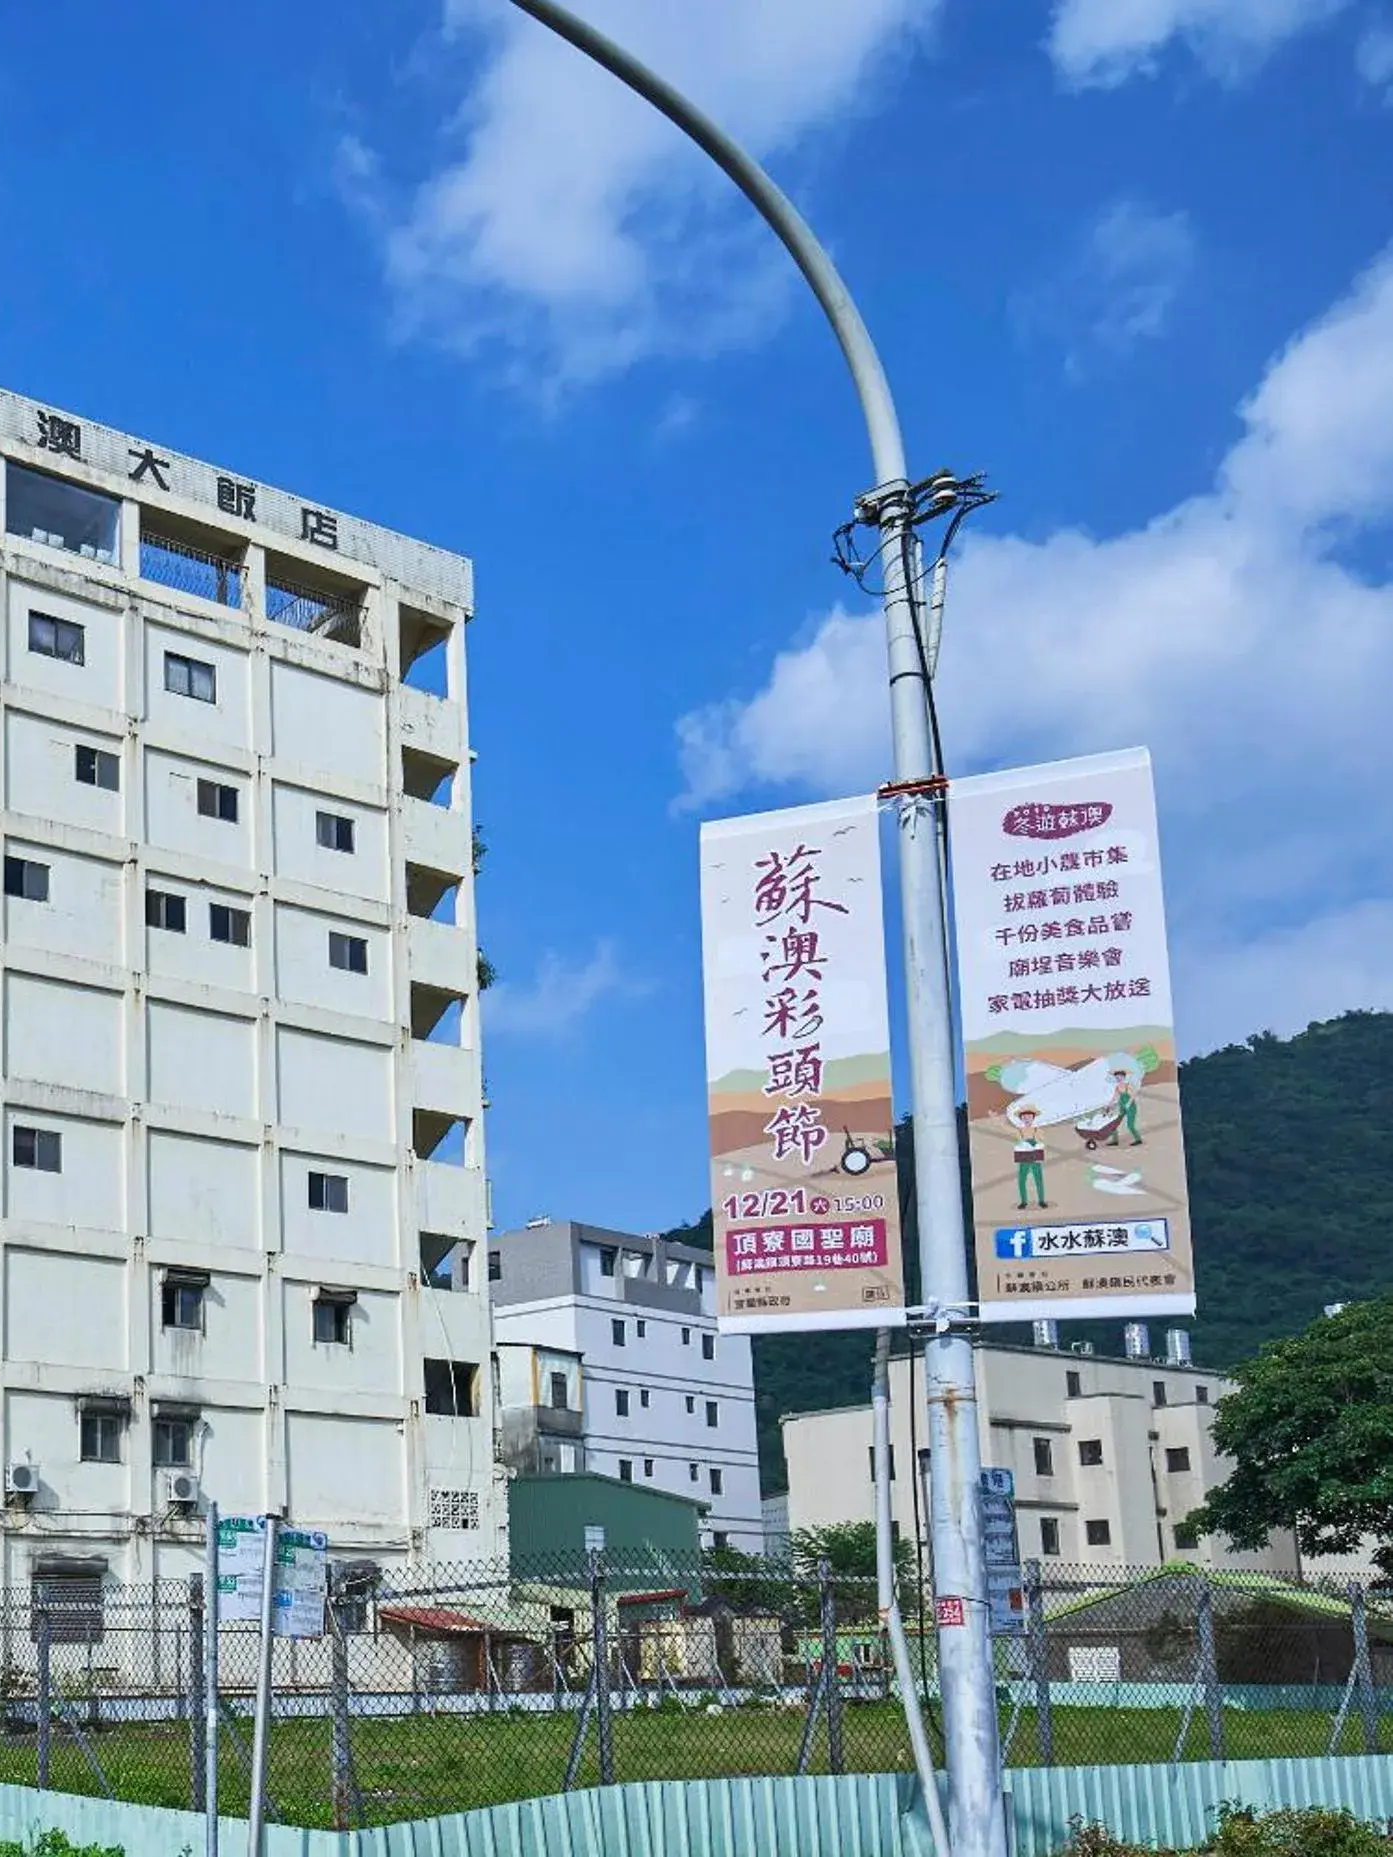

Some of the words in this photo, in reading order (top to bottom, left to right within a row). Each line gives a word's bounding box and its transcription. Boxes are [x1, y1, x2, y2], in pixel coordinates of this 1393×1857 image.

[990, 845, 1129, 883] 在地小農市集
[1003, 879, 1120, 913] 拔蘿蔔體驗
[1008, 946, 1124, 979] 廟埕音樂會
[754, 844, 849, 1162] 蘇澳彩頭節
[987, 977, 1152, 1014] 家電抽獎大放送
[723, 1190, 807, 1219] 12/21
[834, 1195, 885, 1212] 15:00
[733, 1225, 875, 1256] 頂寮國聖廟
[1038, 1227, 1129, 1251] 水水蘇澳
